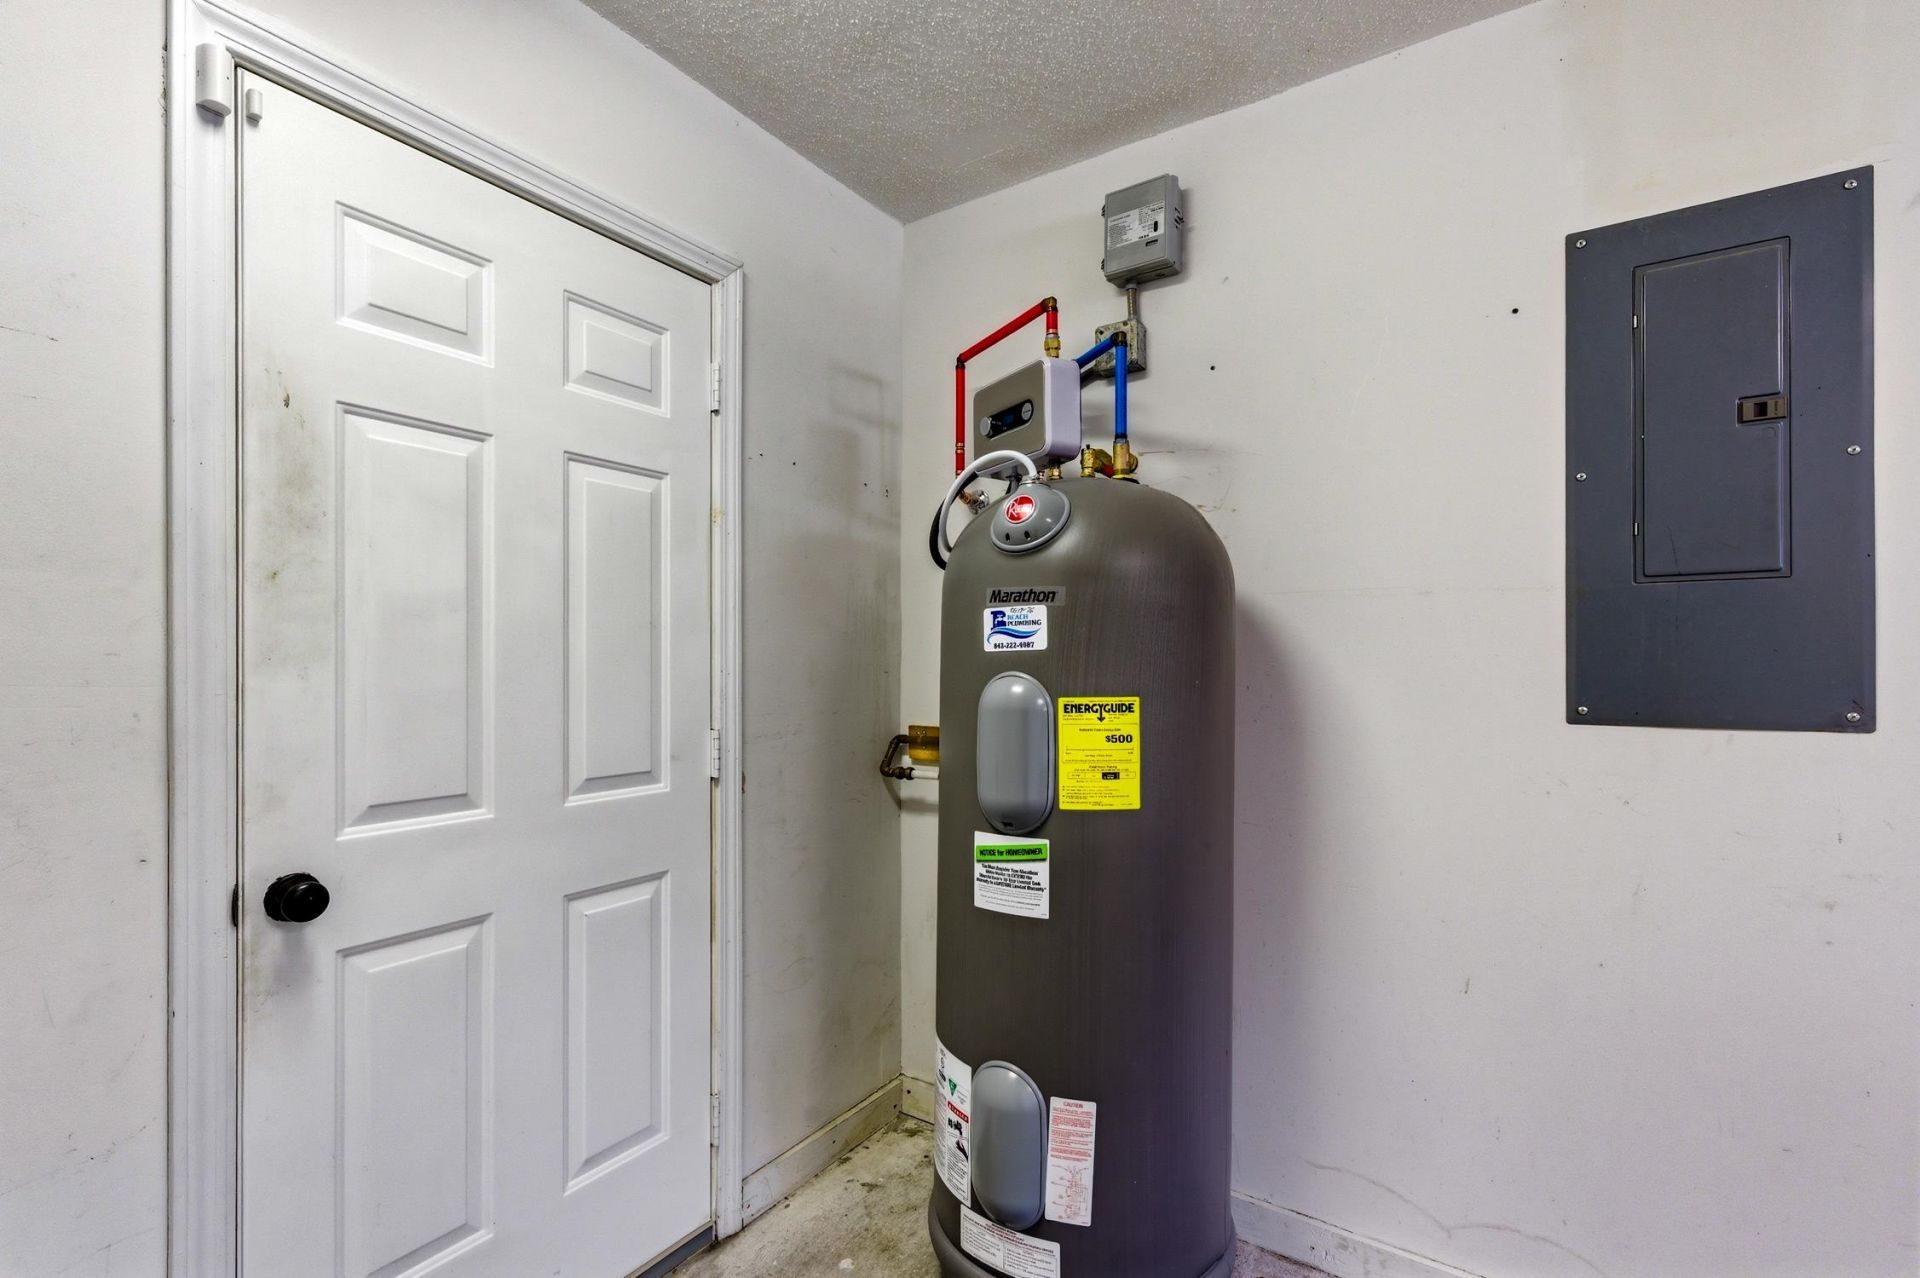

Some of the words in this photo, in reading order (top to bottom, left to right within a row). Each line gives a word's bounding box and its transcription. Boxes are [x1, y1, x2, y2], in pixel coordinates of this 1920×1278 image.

[989, 588, 1057, 603] Marathon
[1063, 703, 1135, 714] ENERGYGUIDE
[1106, 734, 1132, 743] $500
